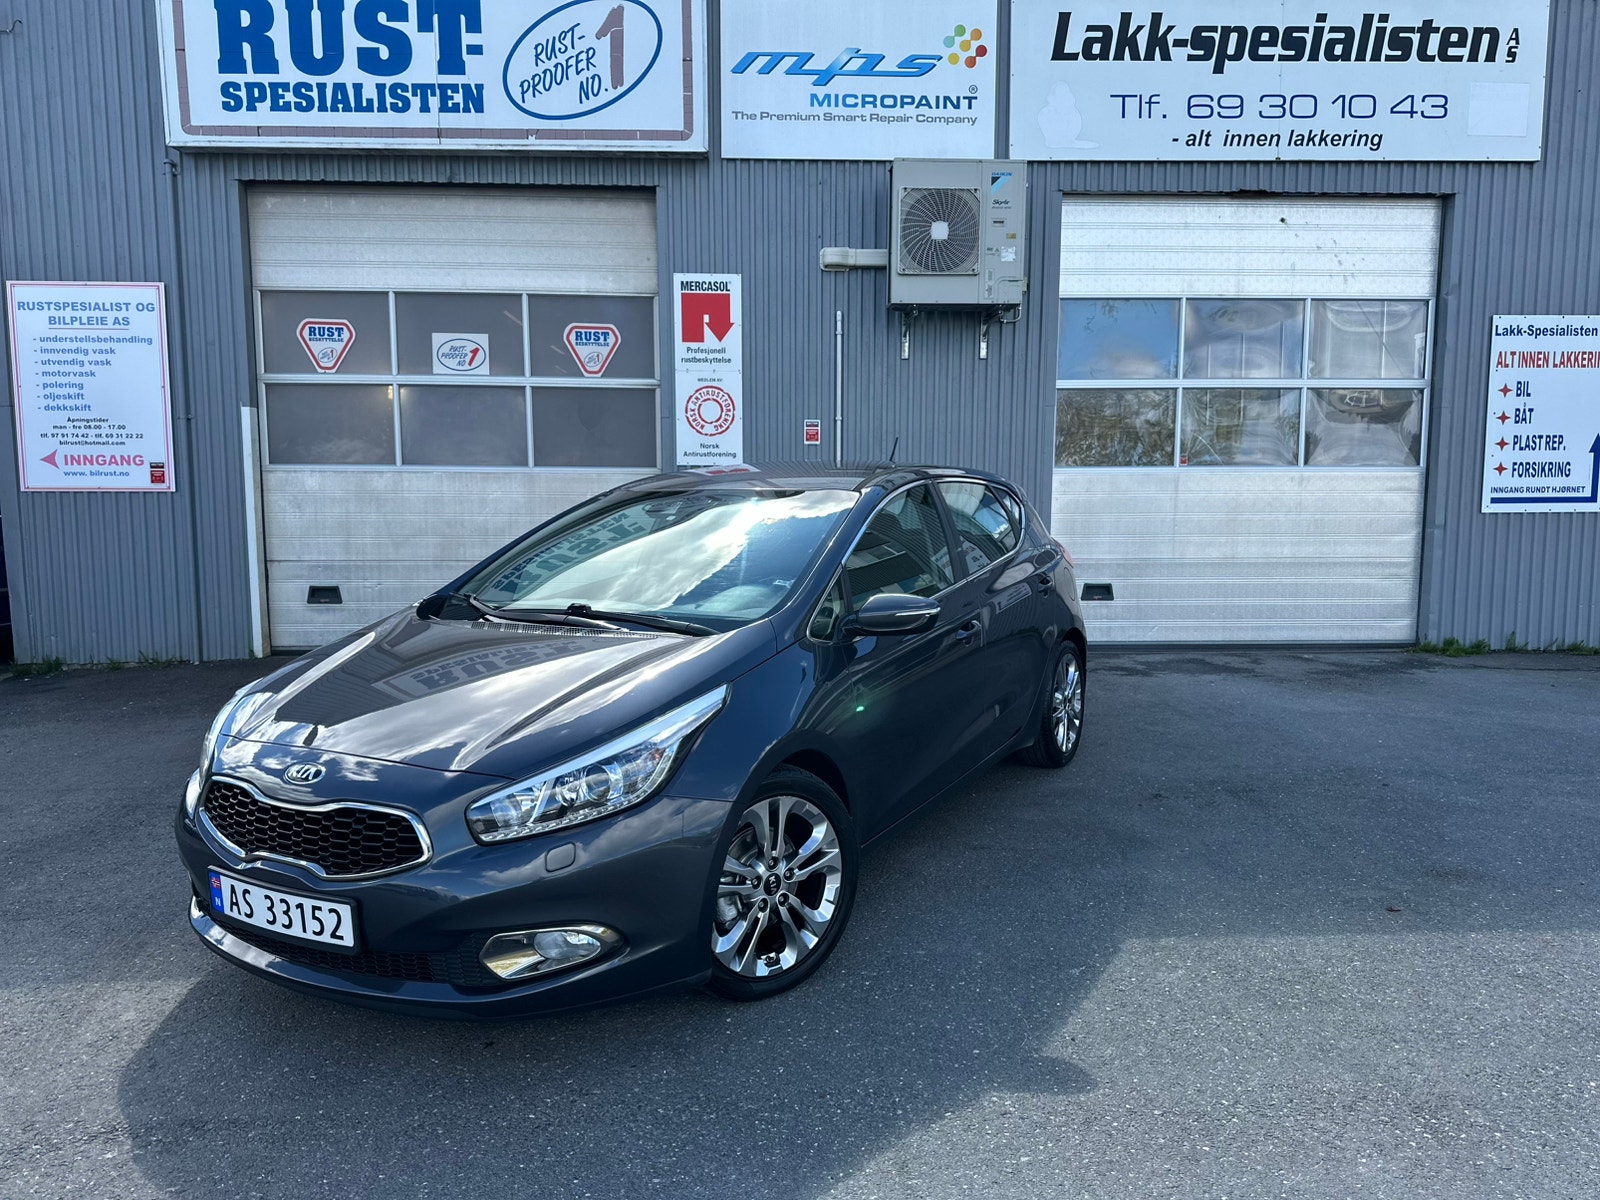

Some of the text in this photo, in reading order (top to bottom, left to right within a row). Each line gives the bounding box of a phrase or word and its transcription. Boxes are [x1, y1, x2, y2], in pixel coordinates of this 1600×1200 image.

[533, 22, 586, 67] RUST-
[1050, 11, 1498, 75] Lakk-spesialisten
[578, 3, 625, 105] NO. 1
[519, 47, 597, 103] PROOFER
[221, 81, 485, 114] SPESIALISTEN
[809, 93, 978, 110] MICROPAINT
[1109, 93, 1449, 119] Tlf. 69 30 10 43
[732, 111, 978, 126] The Premium Smart Repair Company
[1185, 130, 1212, 147] alt
[1223, 130, 1281, 147] innen
[1287, 129, 1384, 151] lakkering
[680, 281, 731, 292] MERCASOL
[17, 301, 156, 312] RUSTSPESIALIST OG
[48, 316, 131, 326] BILPLEIE AS
[1495, 324, 1598, 339] Lakk-Spesialisten
[39, 335, 153, 345] understellsbehandling
[40, 347, 89, 356] innvendig
[92, 347, 116, 355] vask
[468, 347, 480, 367] 1
[686, 346, 726, 355] Profesjonell
[41, 358, 85, 367] utvendig
[88, 358, 112, 366] vask
[681, 356, 732, 364] rustbeskyttelse
[1496, 351, 1517, 368] ALT
[1518, 351, 1550, 368] INNEN
[43, 381, 84, 390] polering
[1516, 381, 1531, 397] BIL
[43, 393, 85, 402] oljeskift
[1514, 402, 1534, 424] BÅT
[64, 454, 145, 466] INNGANG
[683, 451, 737, 459] Antirustforening
[1511, 461, 1571, 478] FORSIKRING
[1551, 485, 1586, 493] HJØRNET
[215, 896, 222, 907] N
[230, 884, 345, 941] AS 33152
